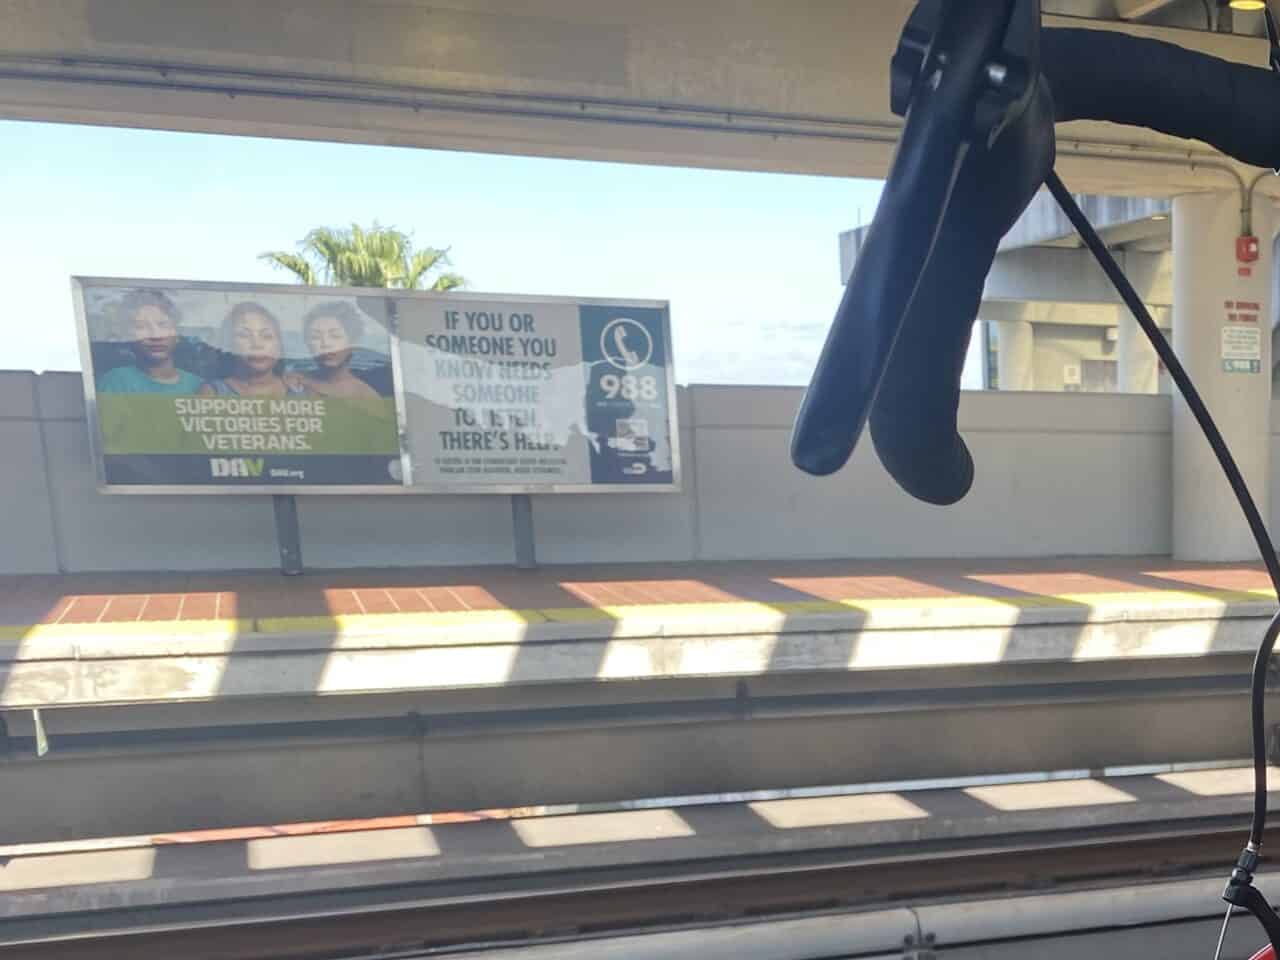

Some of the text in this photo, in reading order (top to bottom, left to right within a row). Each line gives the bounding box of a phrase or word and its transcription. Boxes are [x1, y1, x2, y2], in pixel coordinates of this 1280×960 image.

[444, 310, 535, 332] IF YOU OR
[425, 334, 557, 357] SOMEONE YOU
[453, 384, 539, 402] SOMEONE
[599, 373, 658, 400] 988
[175, 398, 326, 416] SUPPORT MORE
[180, 416, 323, 432] VICTORIES FOR
[202, 434, 312, 449] VETERANS.
[438, 431, 509, 450] THERE'S
[210, 457, 265, 477] DAV
